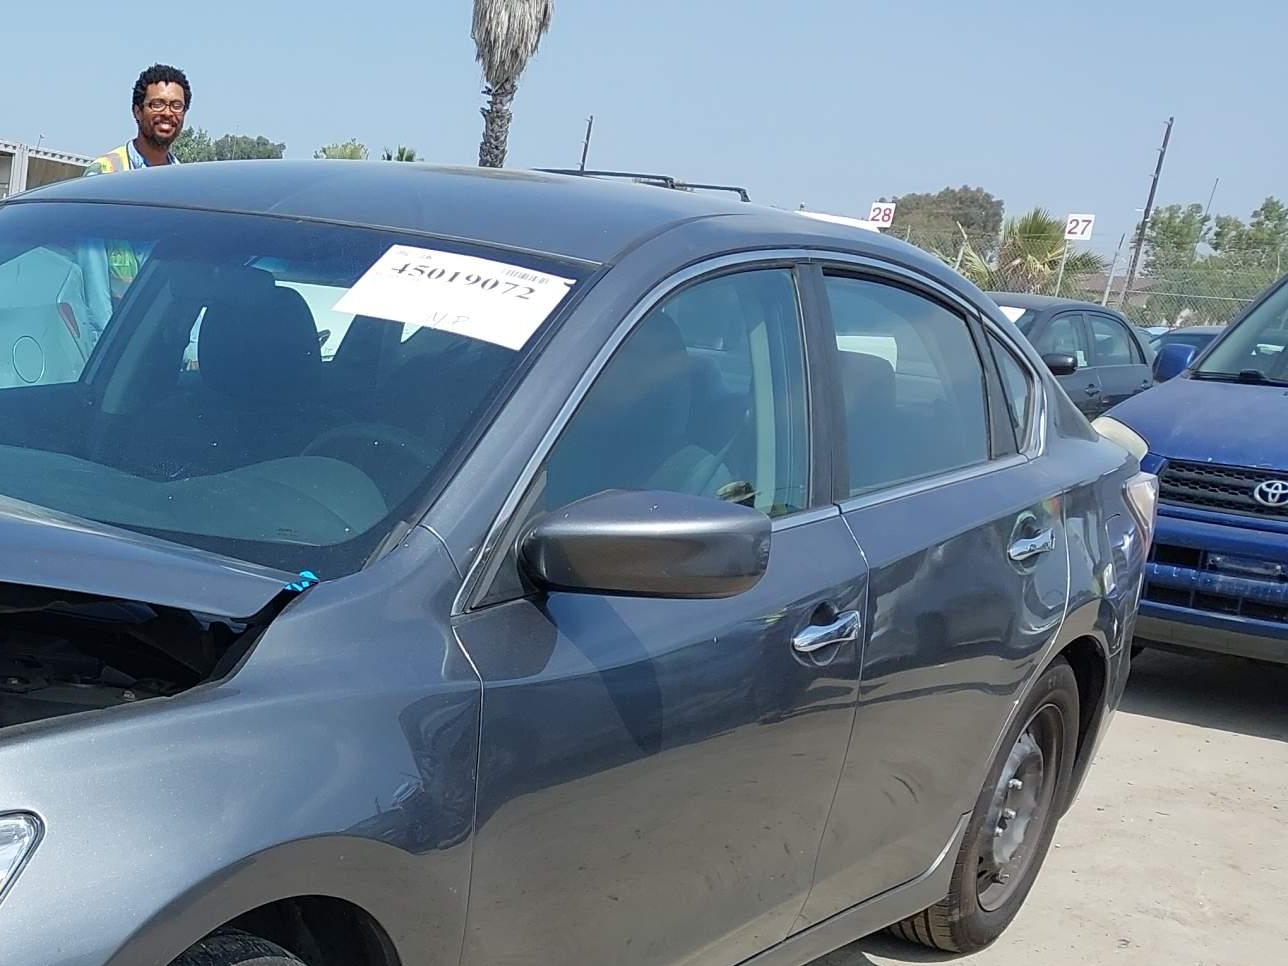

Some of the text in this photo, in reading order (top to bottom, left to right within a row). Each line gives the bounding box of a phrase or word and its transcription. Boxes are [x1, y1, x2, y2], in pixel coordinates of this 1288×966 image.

[870, 207, 892, 223] 28
[1067, 219, 1092, 236] 27
[391, 262, 537, 301] 45019072
